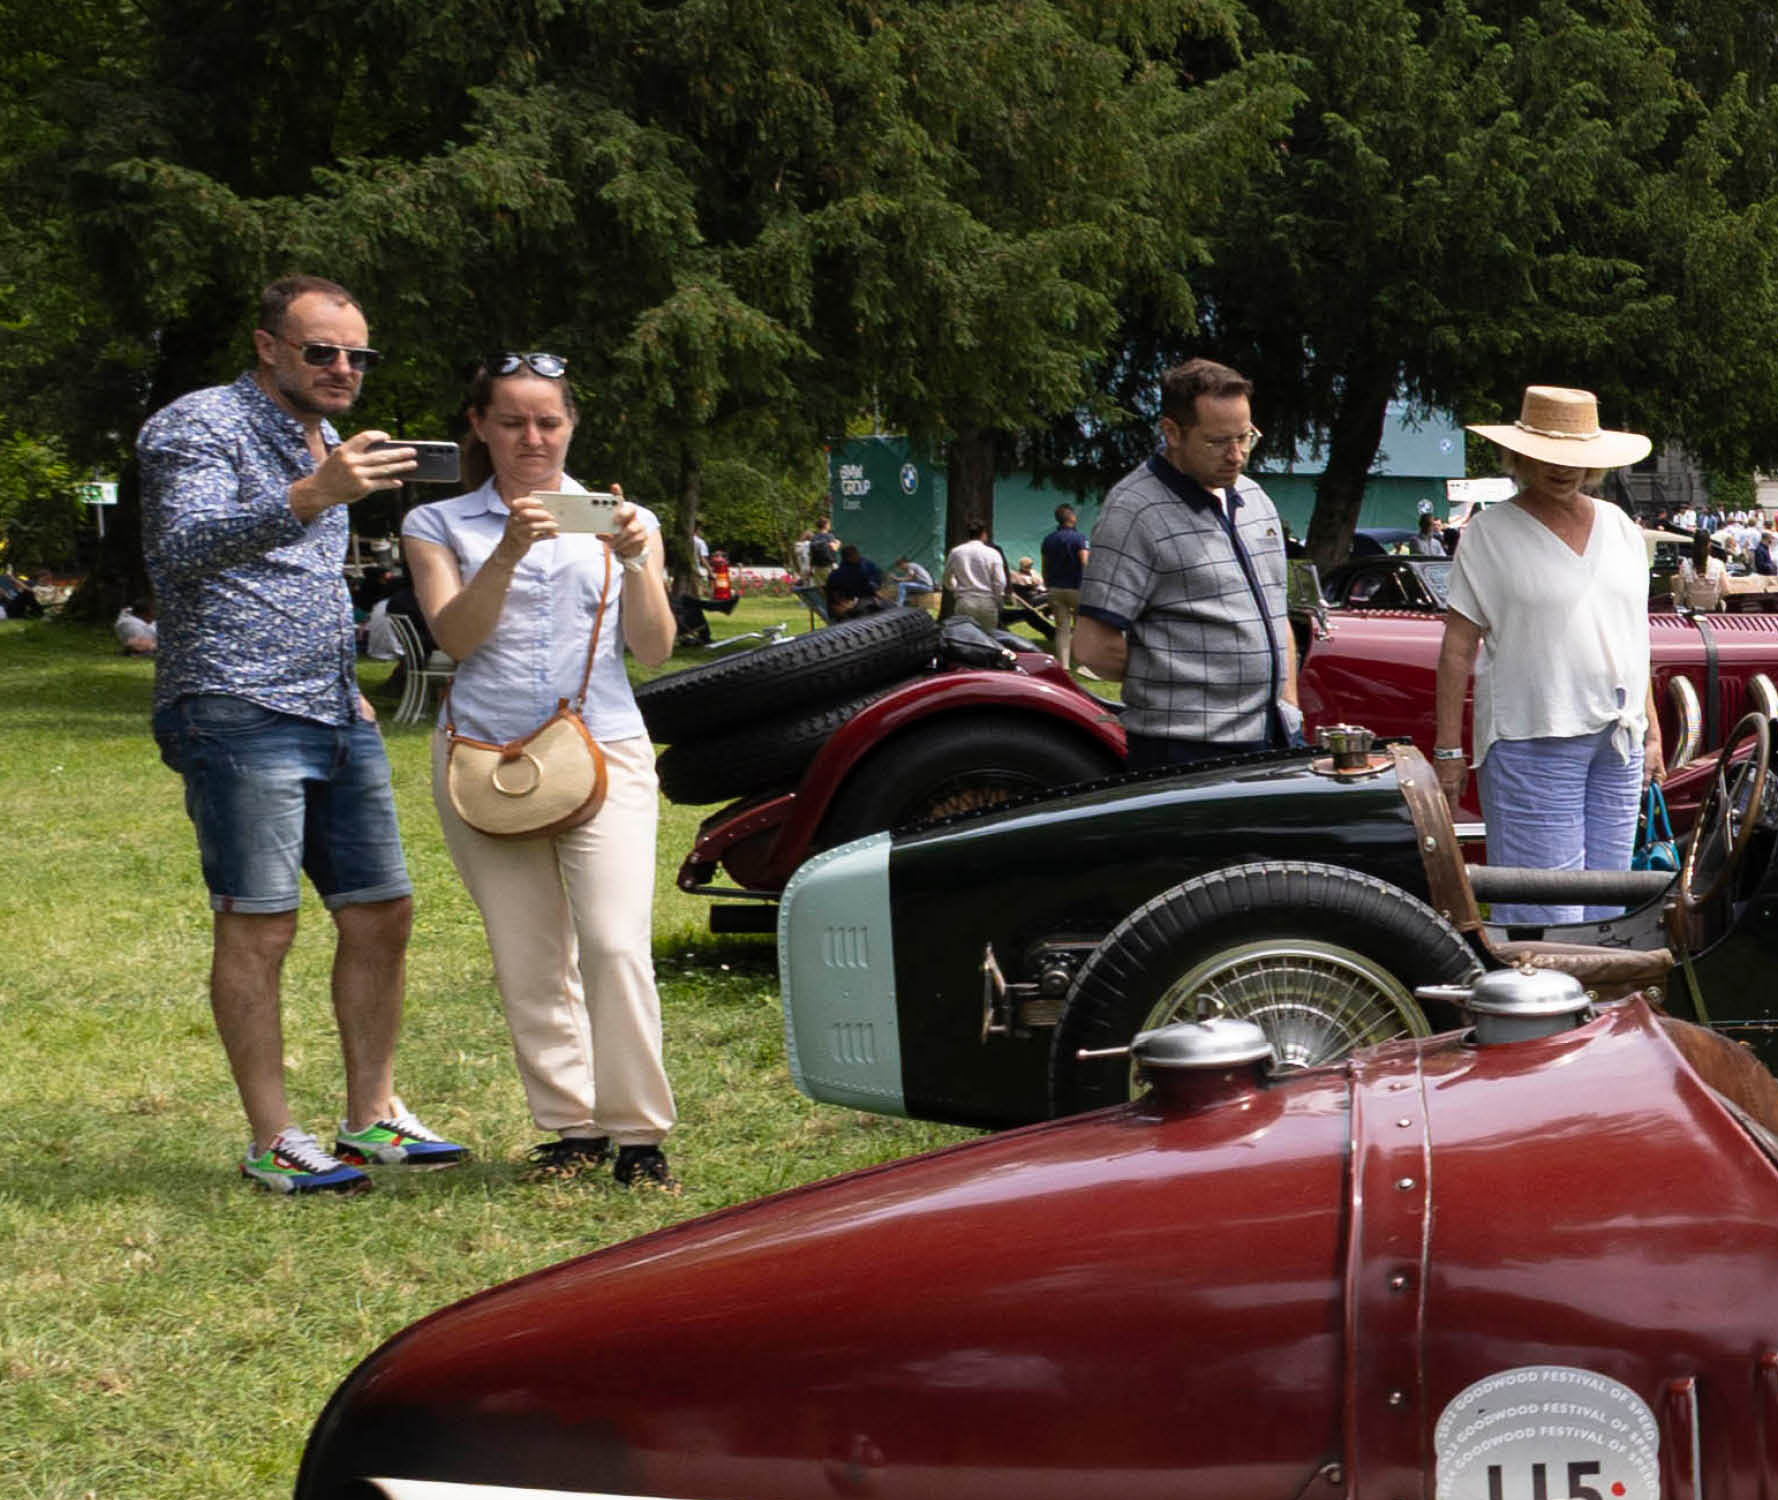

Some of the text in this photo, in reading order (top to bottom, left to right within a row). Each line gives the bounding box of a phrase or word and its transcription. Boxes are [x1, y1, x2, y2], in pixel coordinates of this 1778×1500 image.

[1455, 1371, 1538, 1411] GOODWOOD
[1542, 1371, 1608, 1393] FESTIVAL
[1610, 1387, 1629, 1403] OF
[1628, 1401, 1656, 1441] SPEED
[1456, 1403, 1539, 1443] GOODWOOD
[1542, 1402, 1606, 1424] FESTIVAL
[1610, 1418, 1630, 1432] OF
[1455, 1425, 1657, 1489] GOODWOOD FESTIVAL OF SPEED
